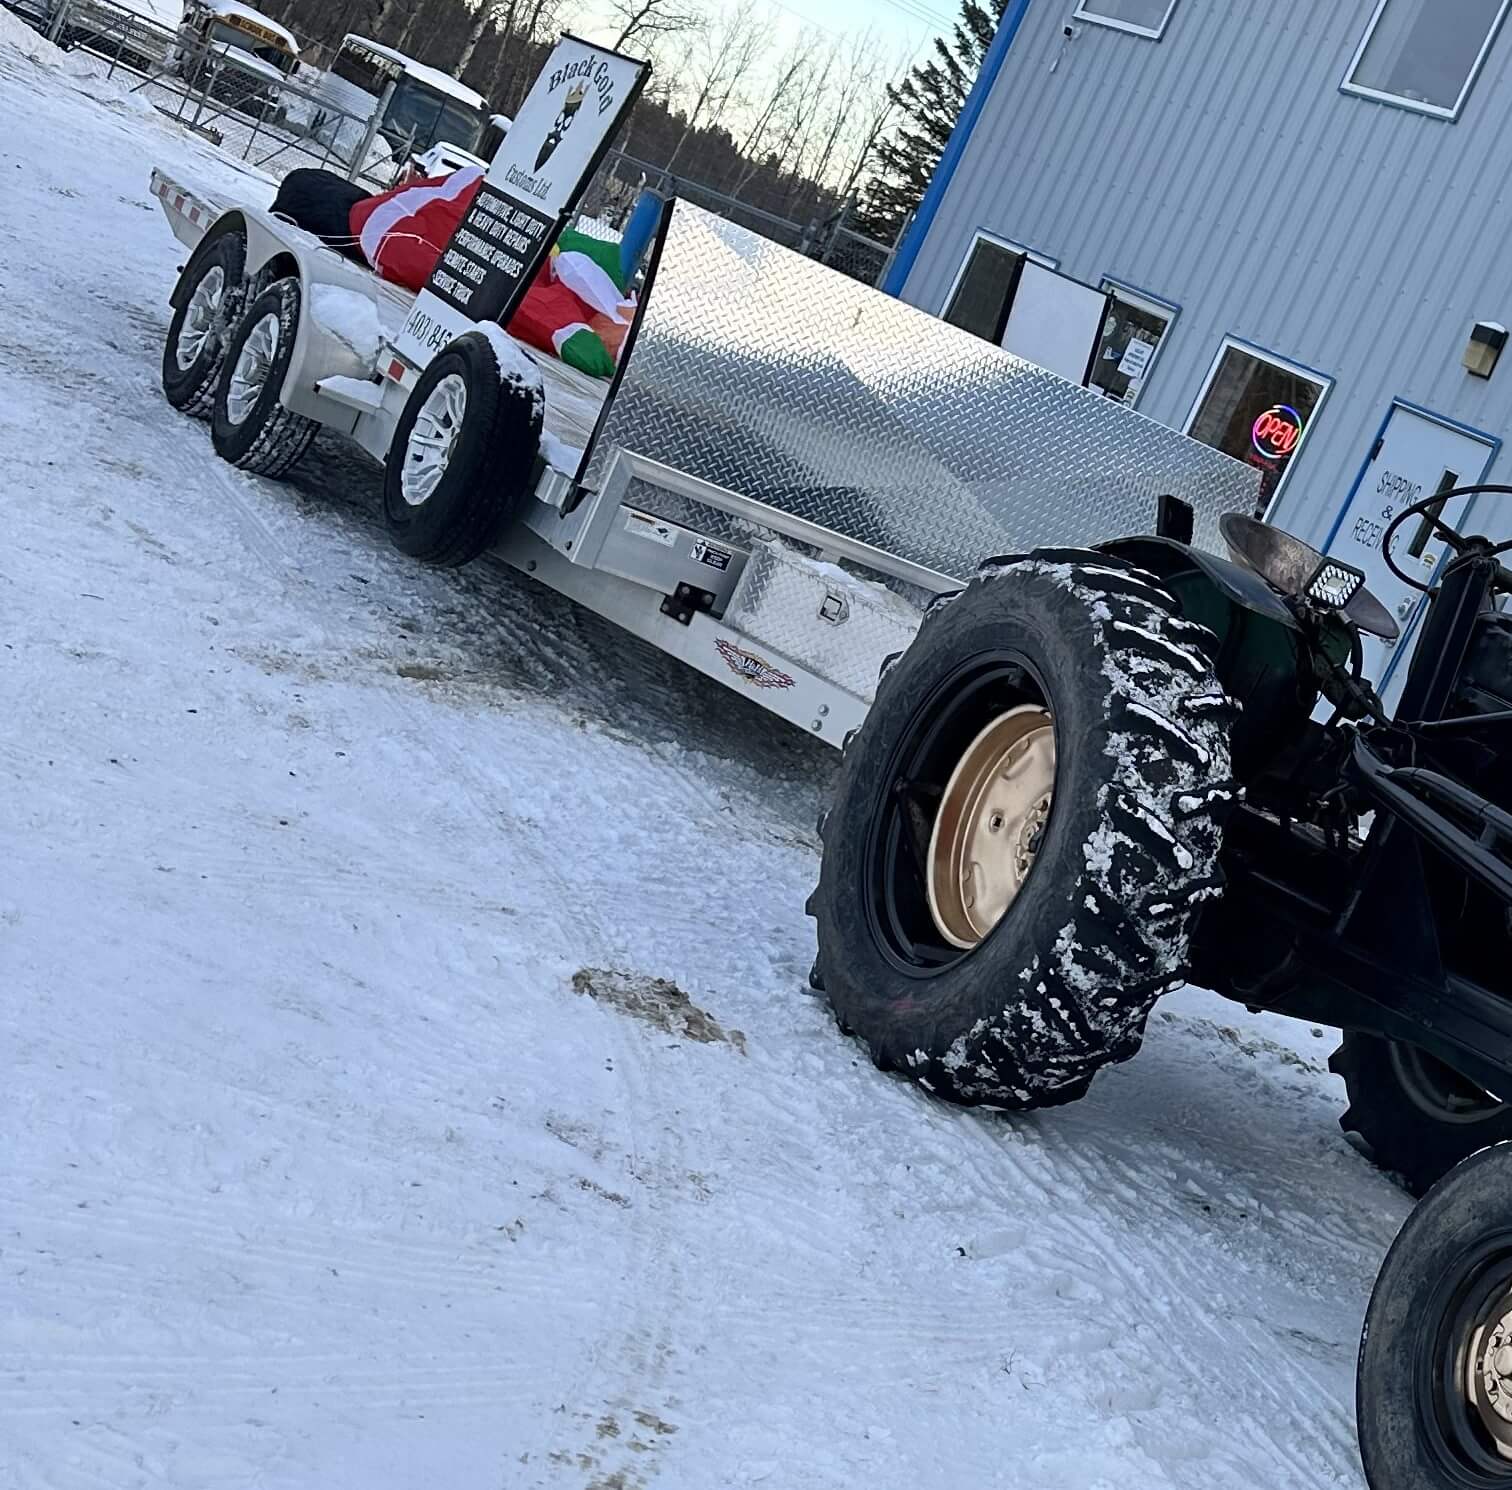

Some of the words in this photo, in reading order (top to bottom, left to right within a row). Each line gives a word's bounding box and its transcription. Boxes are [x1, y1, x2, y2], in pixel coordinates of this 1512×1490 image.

[548, 54, 597, 94] Black
[594, 62, 614, 117] Gold
[1255, 414, 1299, 450] OPEN
[1376, 470, 1422, 508] SHIPPING
[1381, 505, 1394, 521] &
